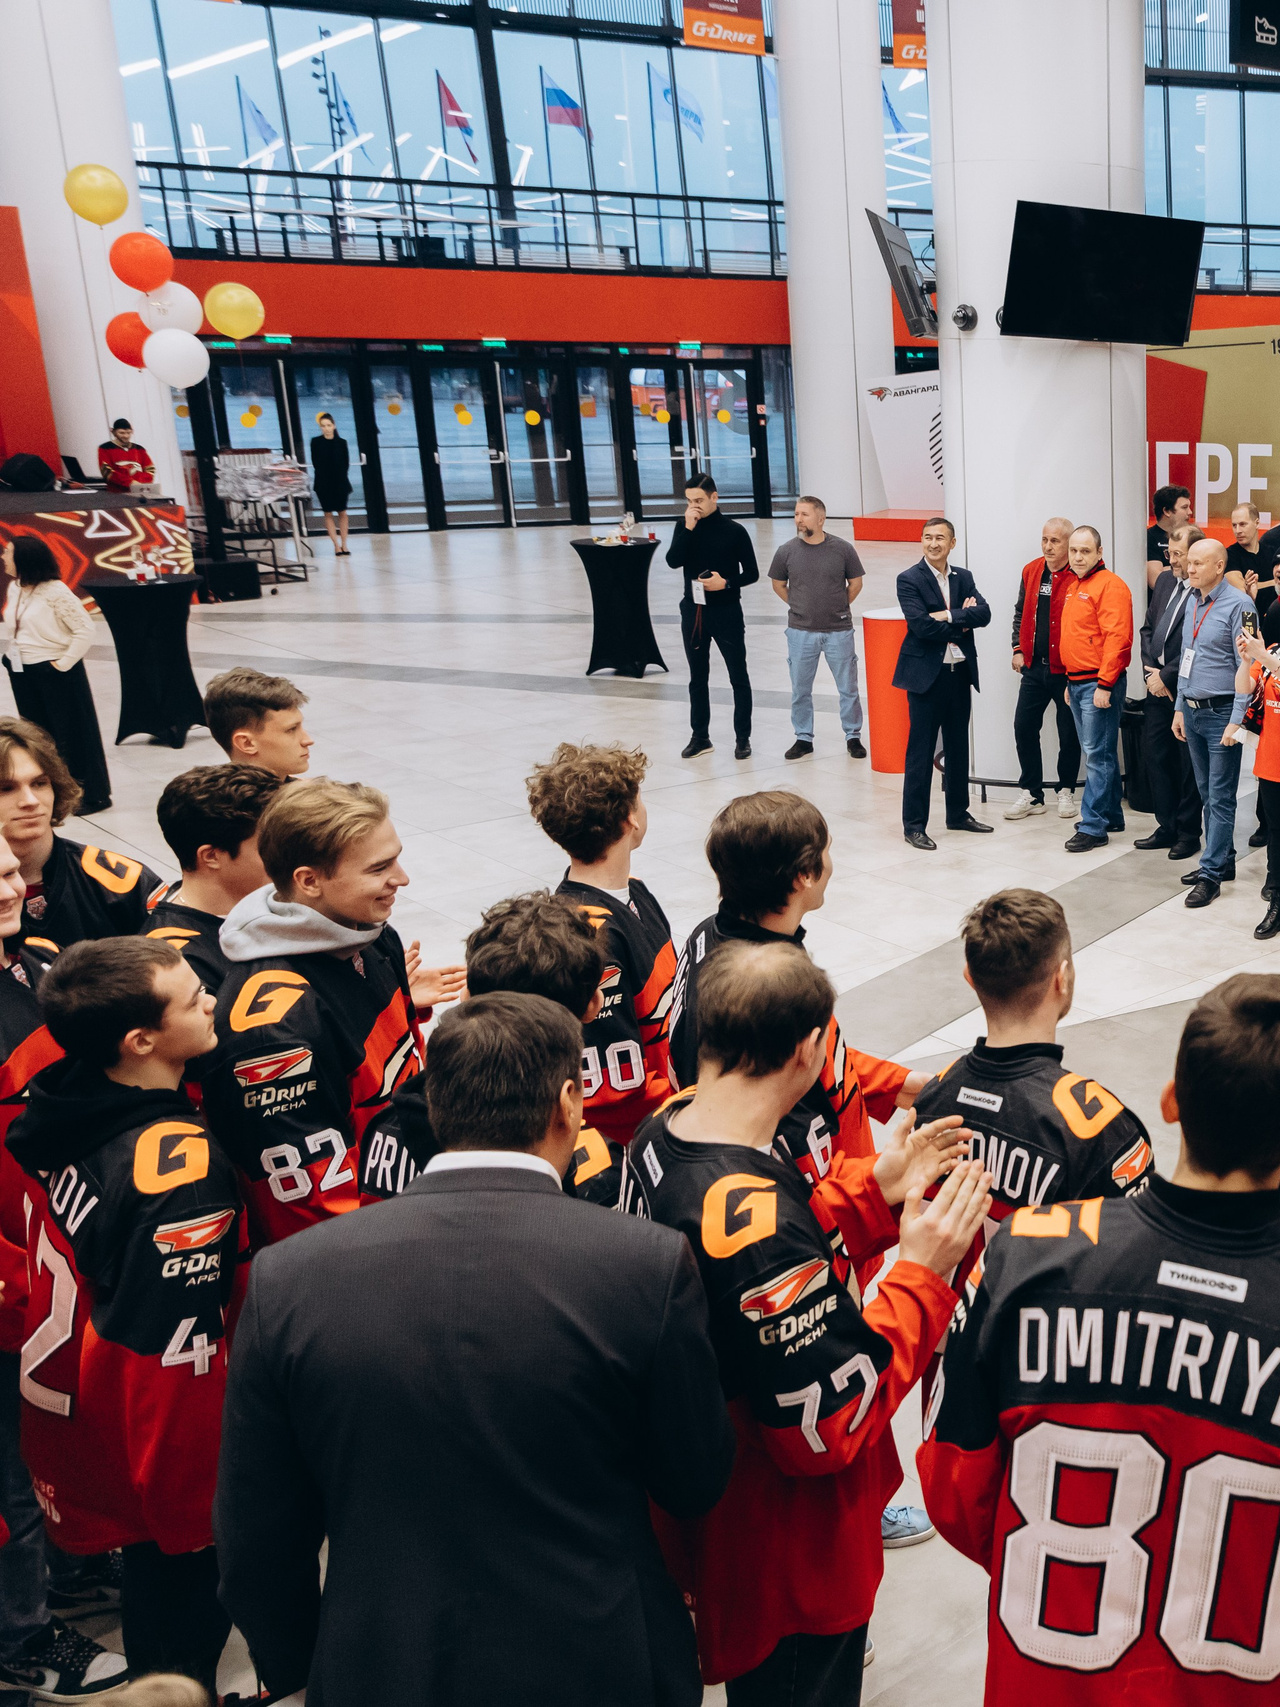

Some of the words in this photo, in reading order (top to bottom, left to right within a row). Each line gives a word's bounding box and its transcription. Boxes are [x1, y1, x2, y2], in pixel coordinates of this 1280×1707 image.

[893, 384, 939, 397] АВАНГАРД
[1146, 441, 1272, 528] ГРЕ
[263, 1099, 306, 1117] АРЕНА
[963, 1092, 997, 1106] ТИНЬКОФФ
[260, 1128, 354, 1202] 82
[364, 1131, 422, 1193] PRI
[1168, 1269, 1238, 1293] ТИНЬКОФФ
[785, 1323, 828, 1357] АРЕНА
[775, 1353, 879, 1454] 77
